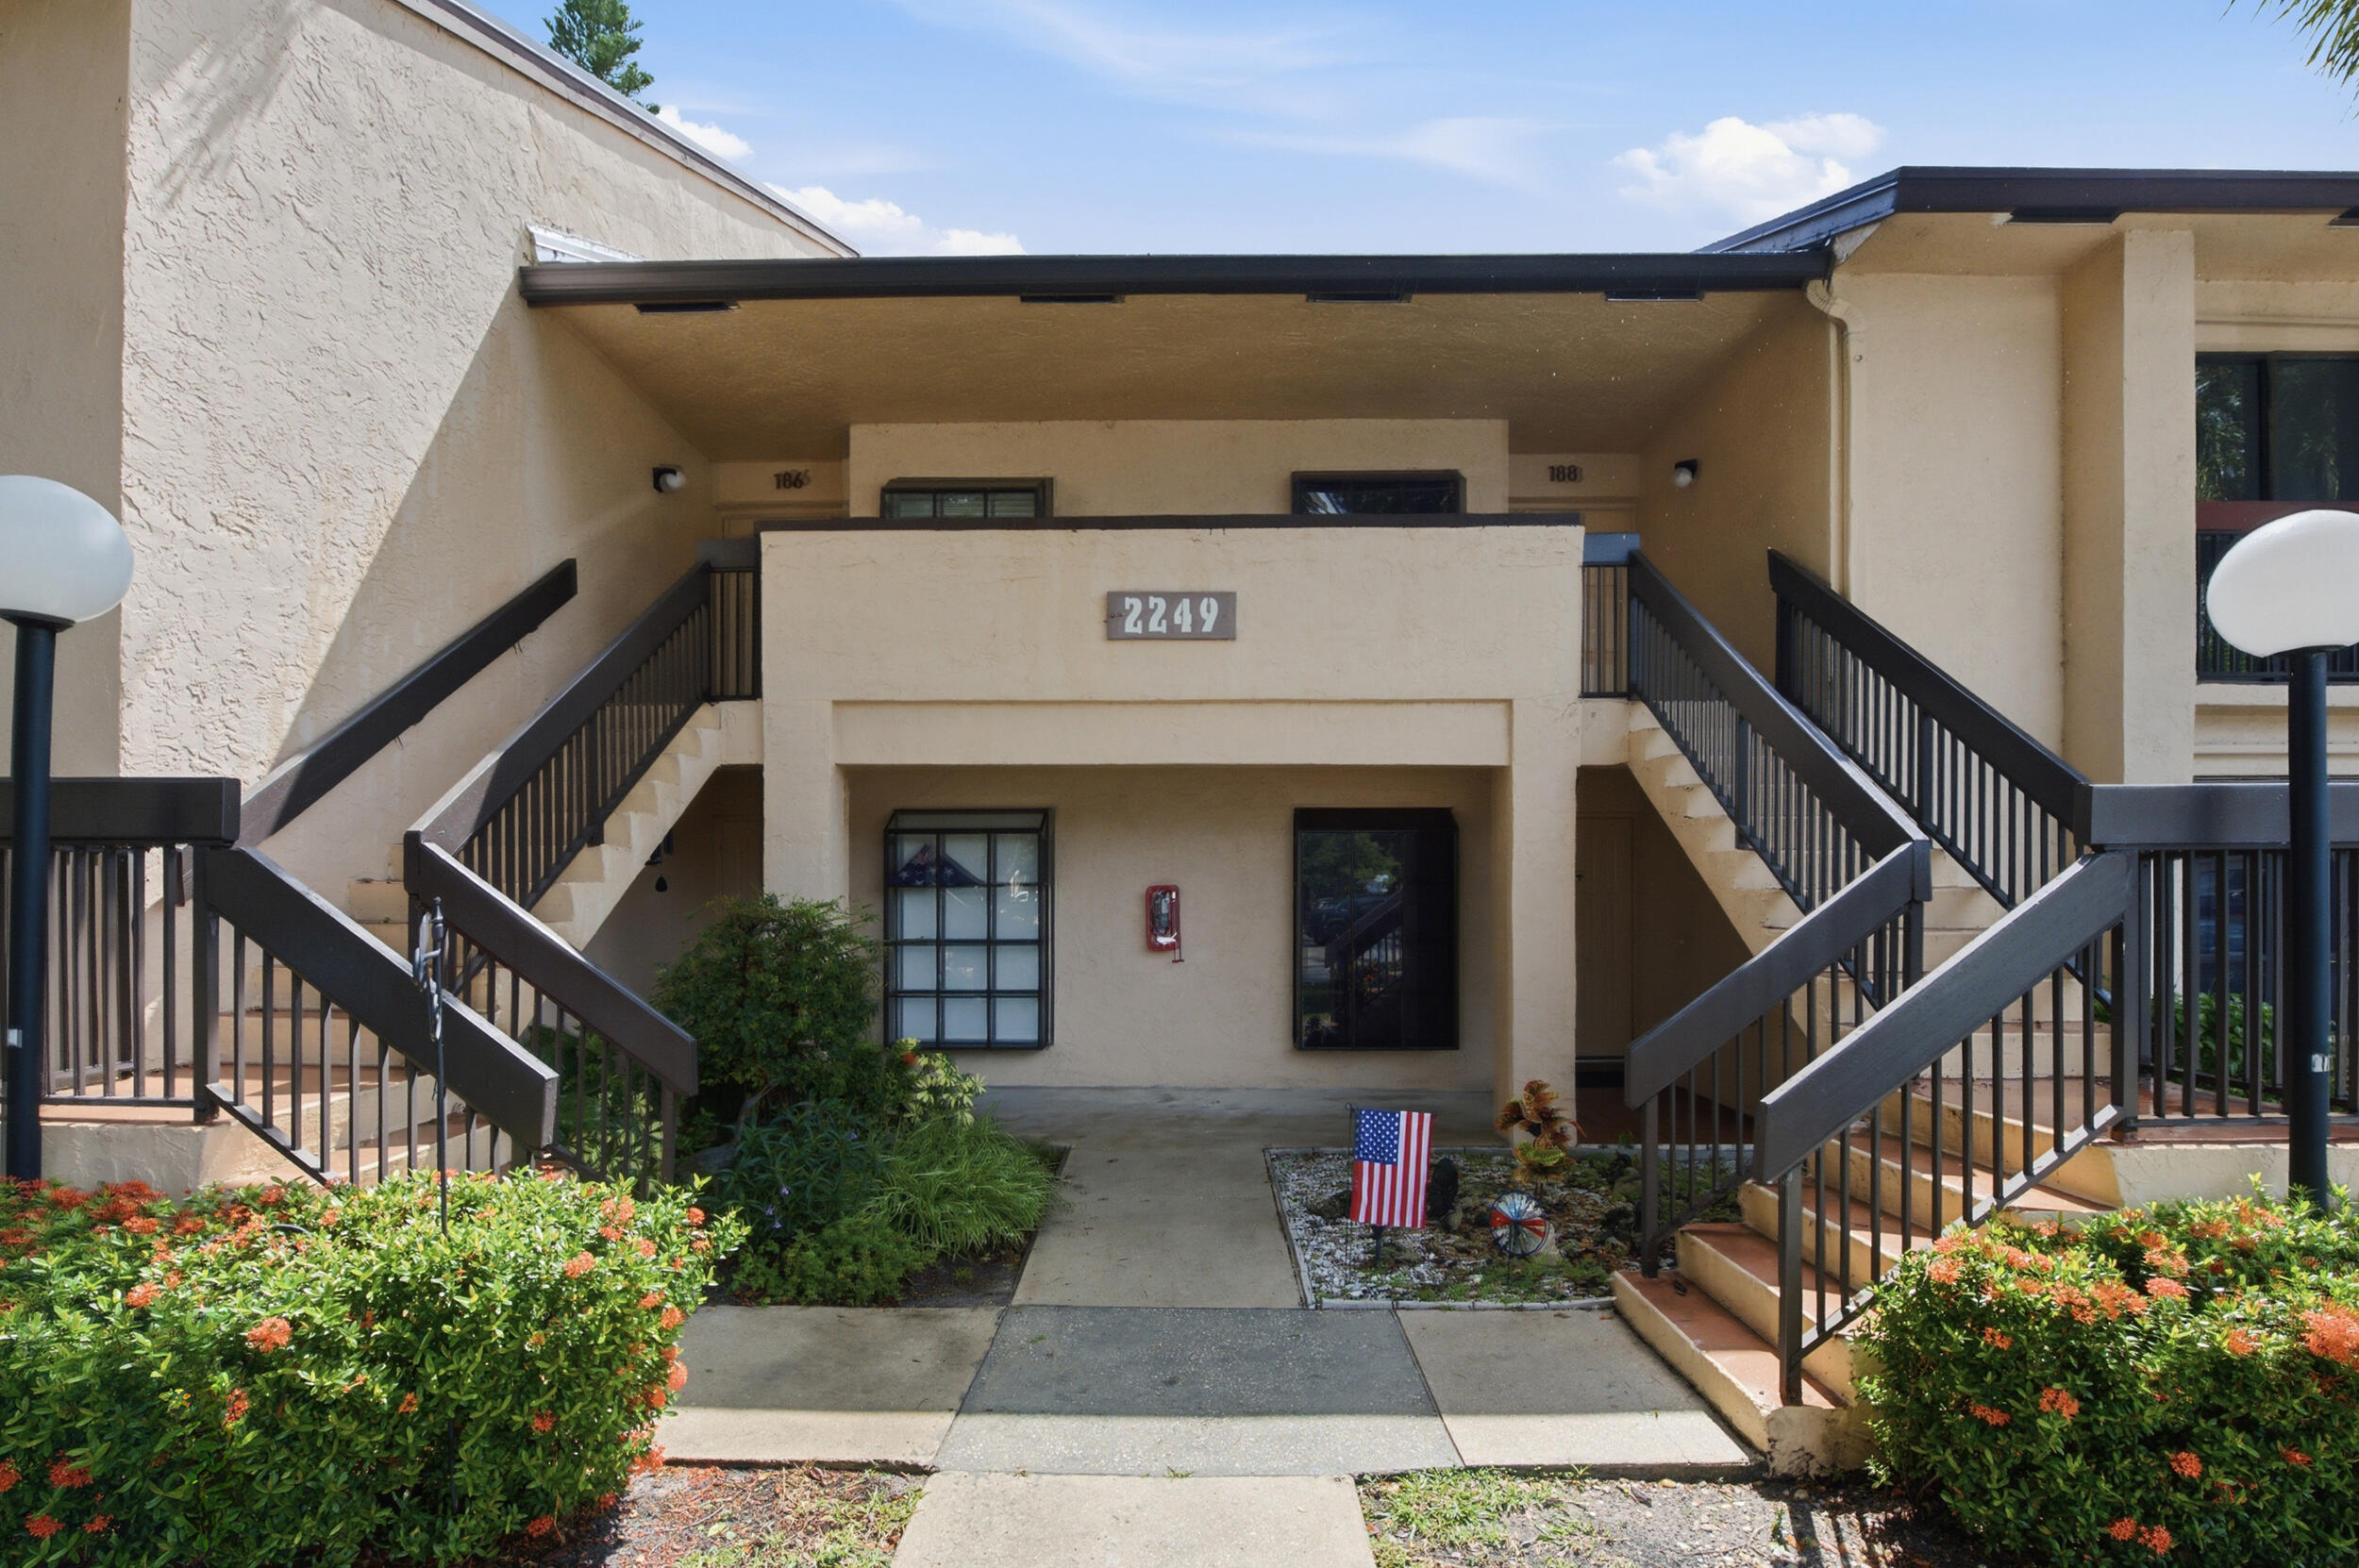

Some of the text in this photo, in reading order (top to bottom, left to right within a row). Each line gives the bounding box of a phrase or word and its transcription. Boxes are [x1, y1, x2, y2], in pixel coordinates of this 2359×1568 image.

[773, 471, 804, 490] 186
[1548, 464, 1579, 483] 188
[1124, 596, 1219, 634] 2249
